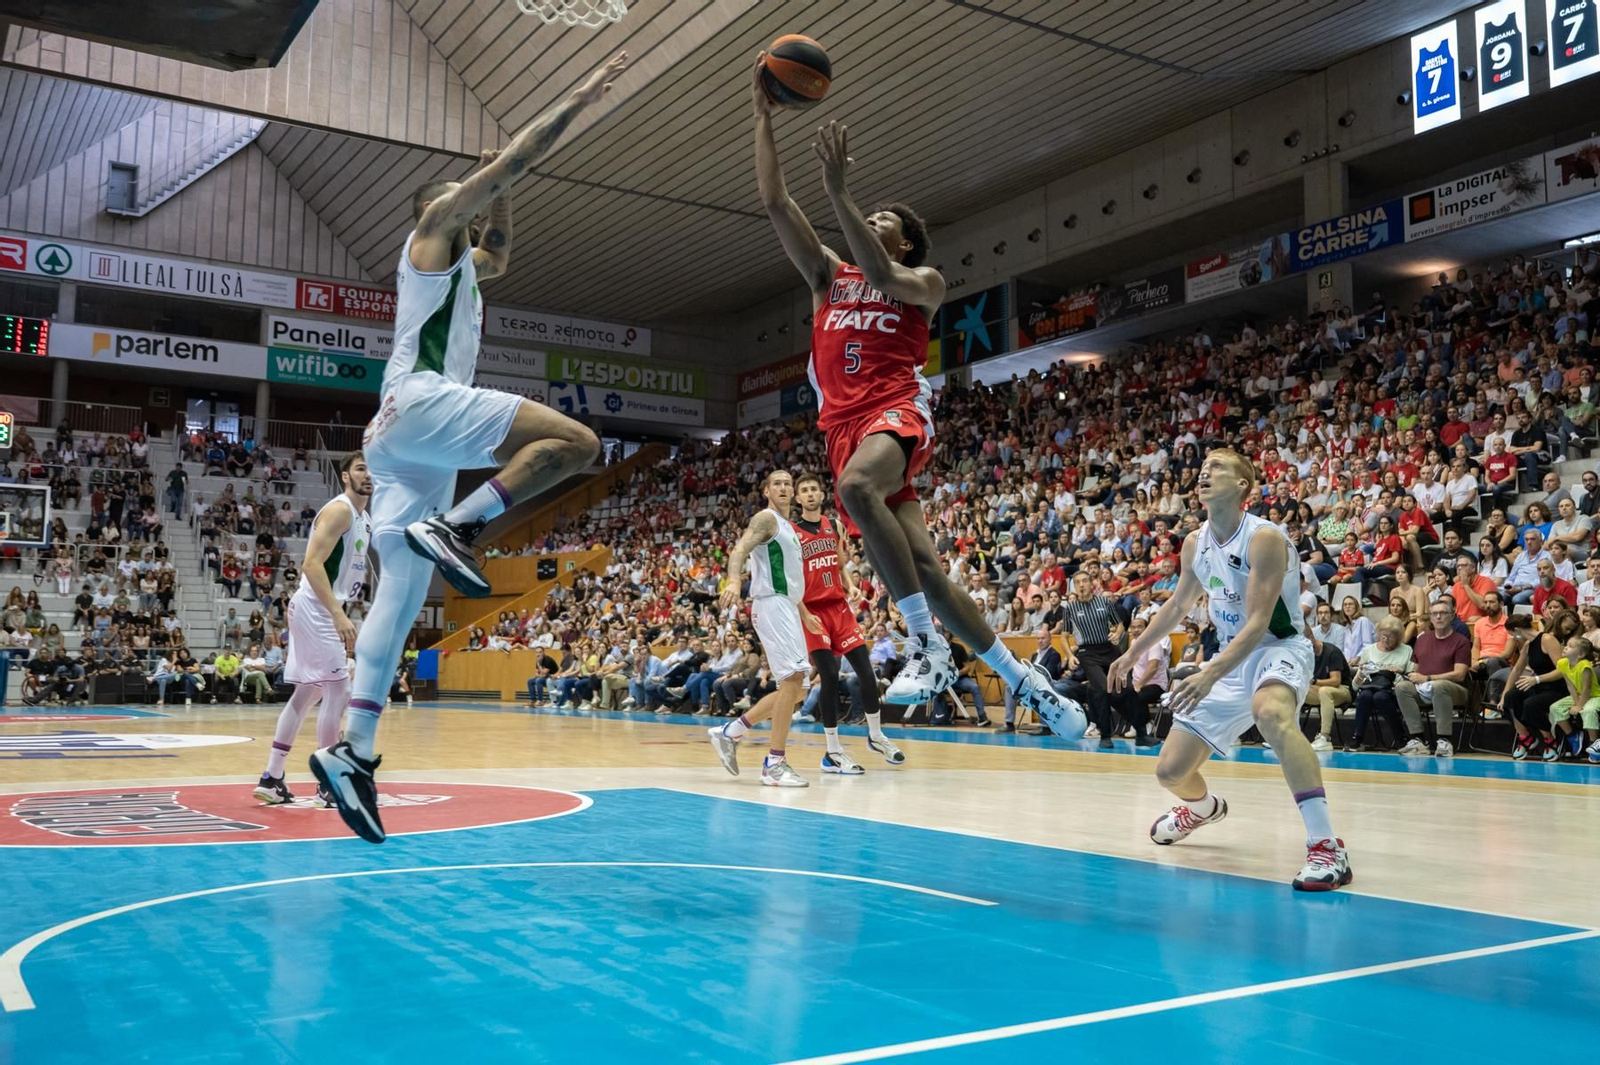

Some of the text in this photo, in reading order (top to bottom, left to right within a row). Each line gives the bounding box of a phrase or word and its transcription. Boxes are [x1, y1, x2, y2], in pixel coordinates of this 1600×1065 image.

[1485, 29, 1516, 46] JORDANA
[1563, 12, 1585, 44] 7
[1490, 41, 1512, 70] 9
[1427, 67, 1442, 95] 7
[1438, 167, 1510, 198] La DIGITAL
[1438, 189, 1497, 217] impser
[1297, 206, 1388, 245] CALSINA
[122, 260, 177, 290] LLEAL
[184, 268, 243, 298] TULSÀ
[1127, 280, 1169, 304] Pacheco
[273, 320, 366, 350] Panella
[823, 309, 901, 334] FIATC
[115, 334, 219, 363] parlem
[844, 342, 862, 374] 5
[275, 353, 367, 380] wifiboo
[562, 357, 694, 394] L'ESPORTIU
[626, 400, 699, 417] Pirineu de Girona
[802, 538, 838, 560] GIRONA
[808, 554, 839, 572] FIATC
[822, 571, 834, 588] 11
